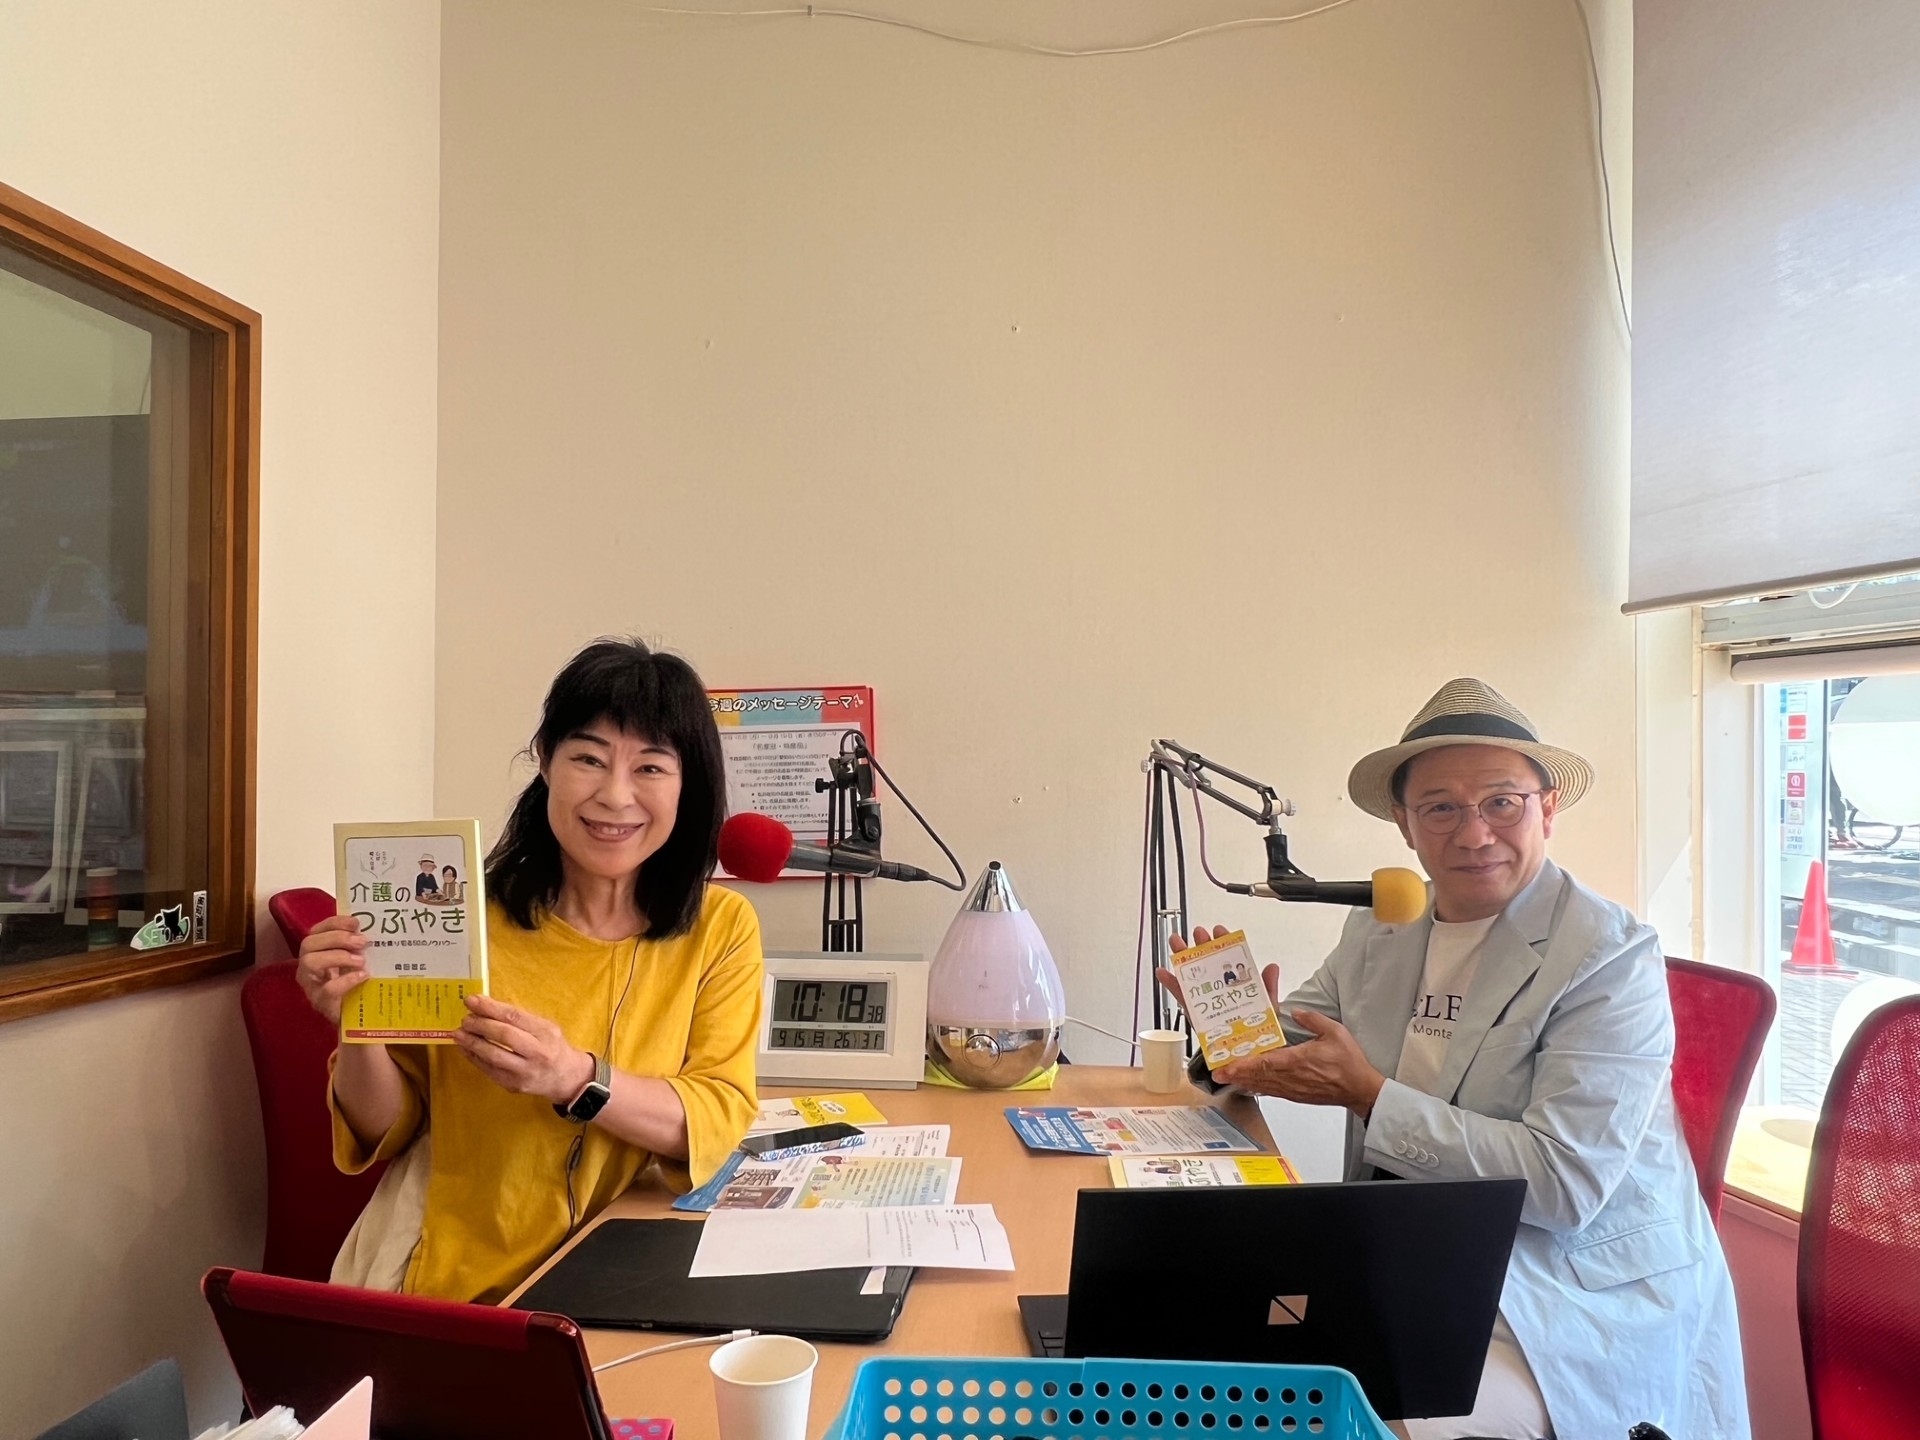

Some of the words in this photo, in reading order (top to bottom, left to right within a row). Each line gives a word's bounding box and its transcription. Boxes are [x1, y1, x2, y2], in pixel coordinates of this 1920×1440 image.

[350, 882, 411, 903] 介護の
[350, 907, 466, 934] つぶやき
[790, 983, 868, 1022] 10:18
[1194, 983, 1260, 1015] つぶやき
[1412, 994, 1463, 1022] LF
